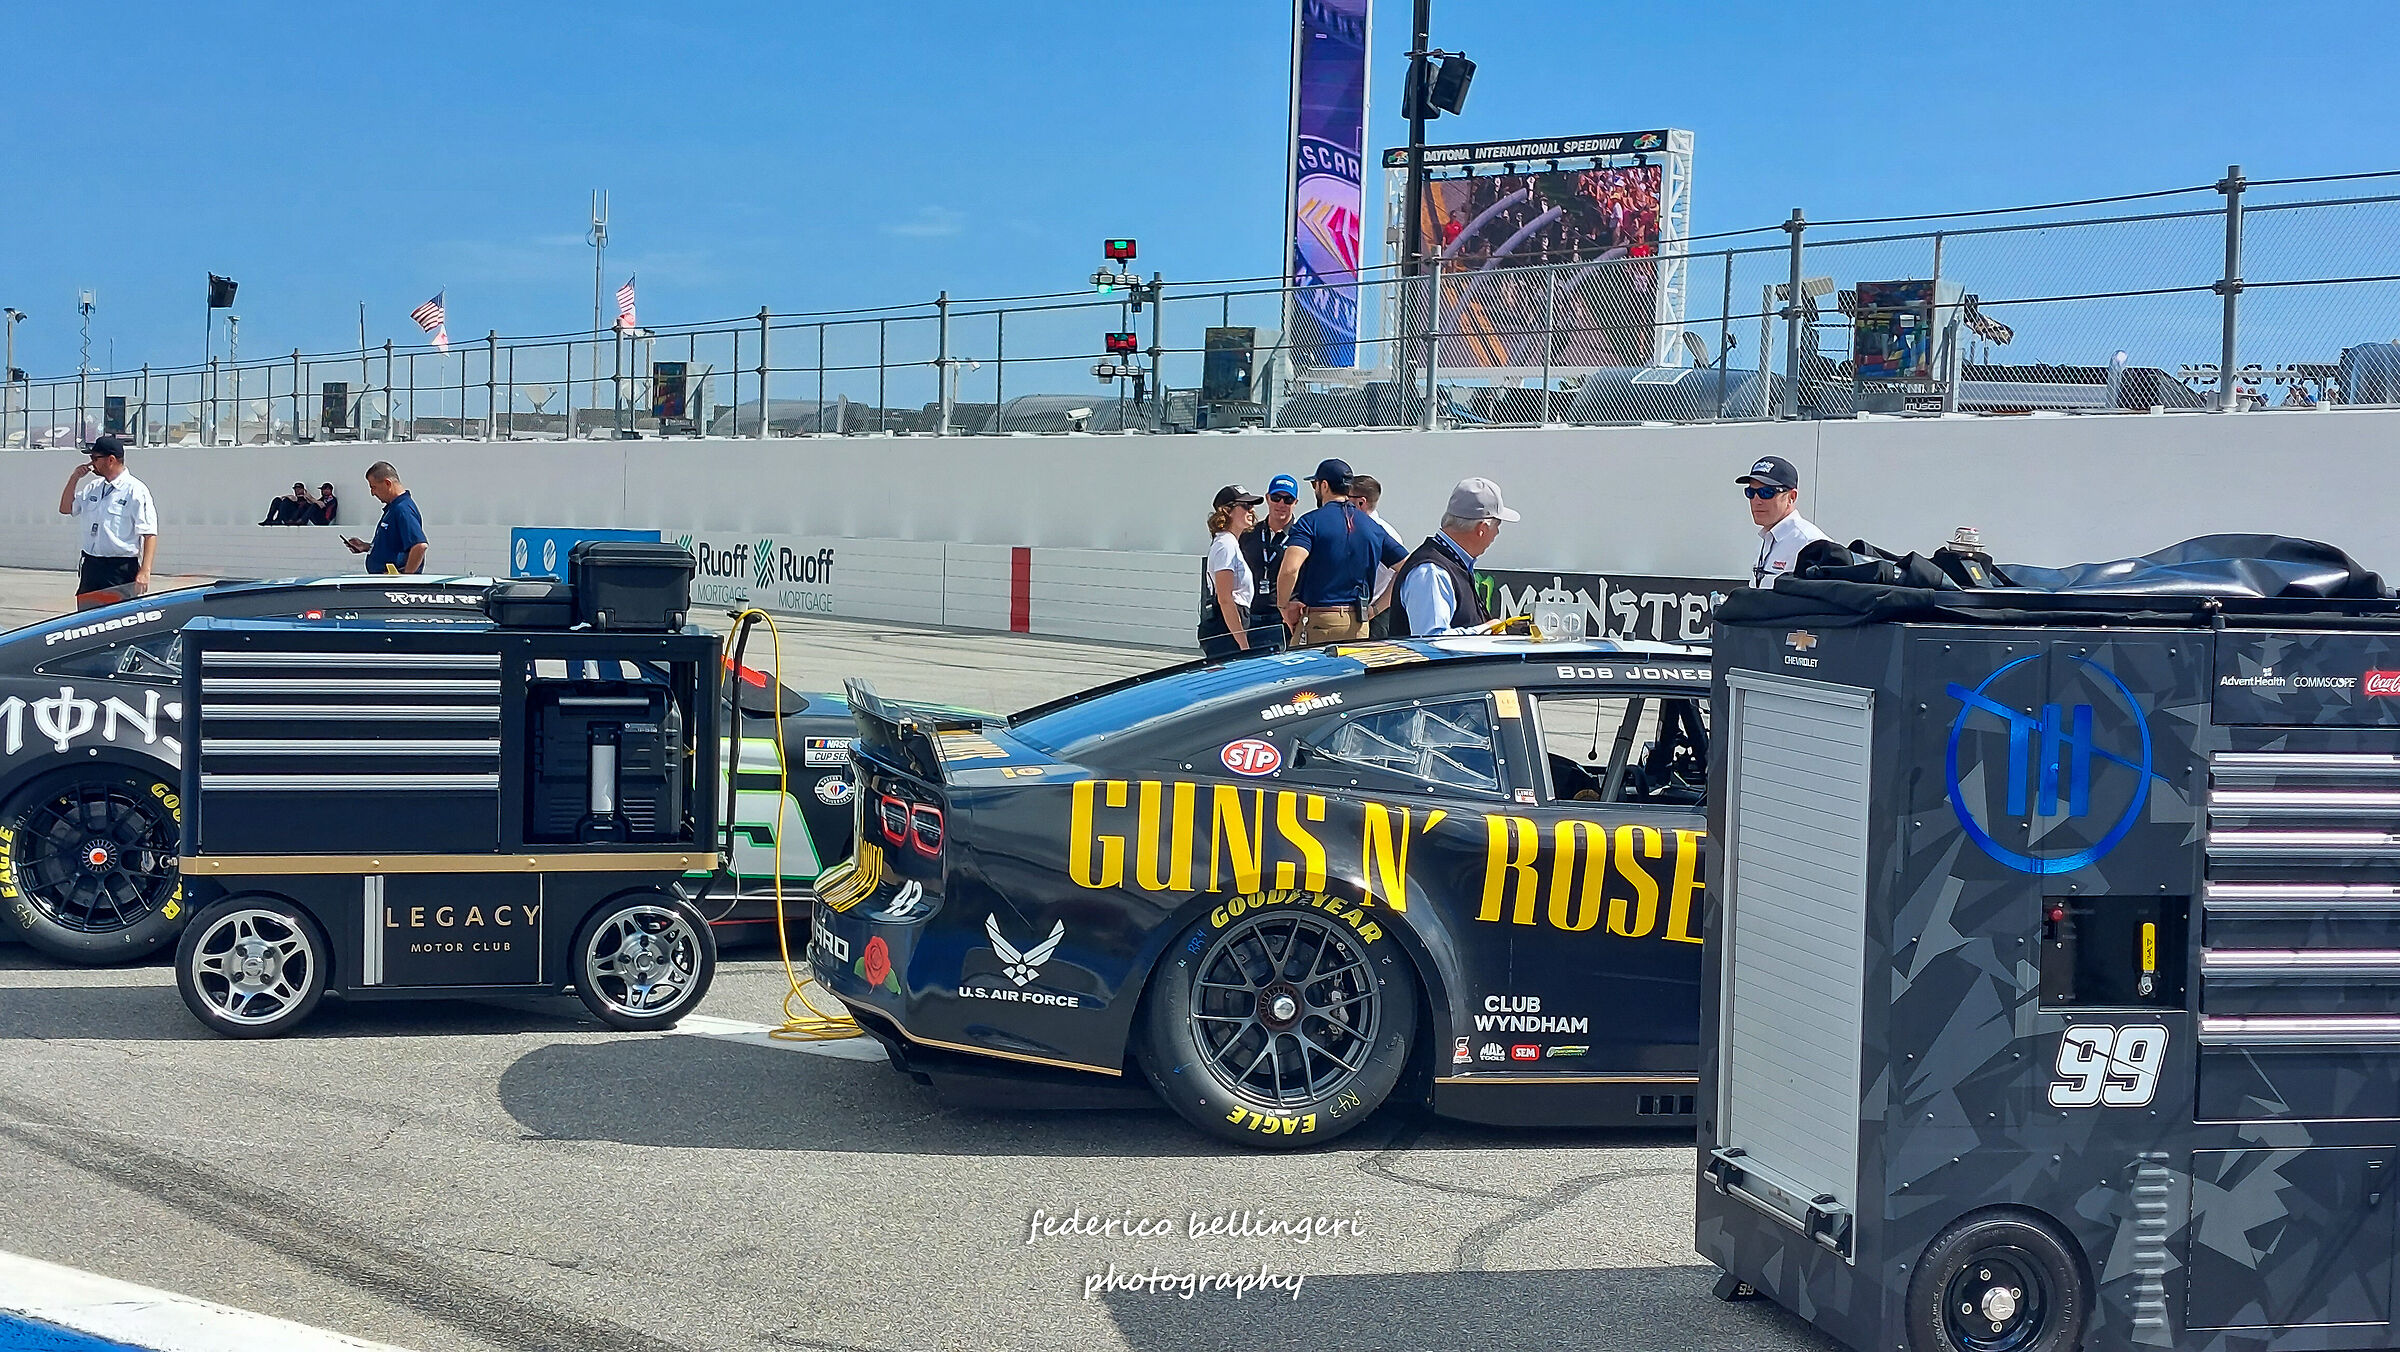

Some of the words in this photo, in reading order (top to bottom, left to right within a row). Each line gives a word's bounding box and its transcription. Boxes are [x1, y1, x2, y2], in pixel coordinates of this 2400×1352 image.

[1423, 148, 1471, 163] DAYTONA
[1474, 142, 1561, 160] INTERNATIONAL
[1563, 137, 1624, 153] SPEEDWAY
[698, 543, 749, 578] Ruoff
[779, 547, 835, 585] Ruoff
[407, 594, 455, 604] TYLER
[697, 585, 748, 603] MORTGAGE
[778, 590, 833, 612] MORTGAGE
[45, 610, 163, 646] Pinnacle
[1784, 655, 1819, 668] CHEVROLET
[1556, 666, 1614, 679] BOB
[1625, 666, 1712, 681] JONES
[2220, 676, 2286, 687] AdventHealth
[2293, 677, 2357, 688] COMMSCOPE
[1261, 692, 1344, 720] allegiant
[815, 752, 833, 761] CUP
[1228, 743, 1275, 770] STP
[1069, 780, 1328, 895] GUNS
[0, 825, 19, 899] EAGLE
[386, 905, 540, 928] LEGACY
[1210, 889, 1383, 945] GOODYEAR
[411, 943, 464, 953] MOTOR
[472, 942, 511, 952] CLUB
[959, 986, 989, 999] U.S.
[990, 989, 1019, 1002] AIR
[1021, 992, 1079, 1008] FORCE
[1485, 995, 1541, 1012] CLUB
[1474, 1014, 1588, 1034] WYNDHAM
[1480, 1043, 1505, 1056] MAC
[1515, 1048, 1536, 1058] SEM
[2048, 1024, 2169, 1108] 99
[1226, 1104, 1318, 1135] EAGLE
